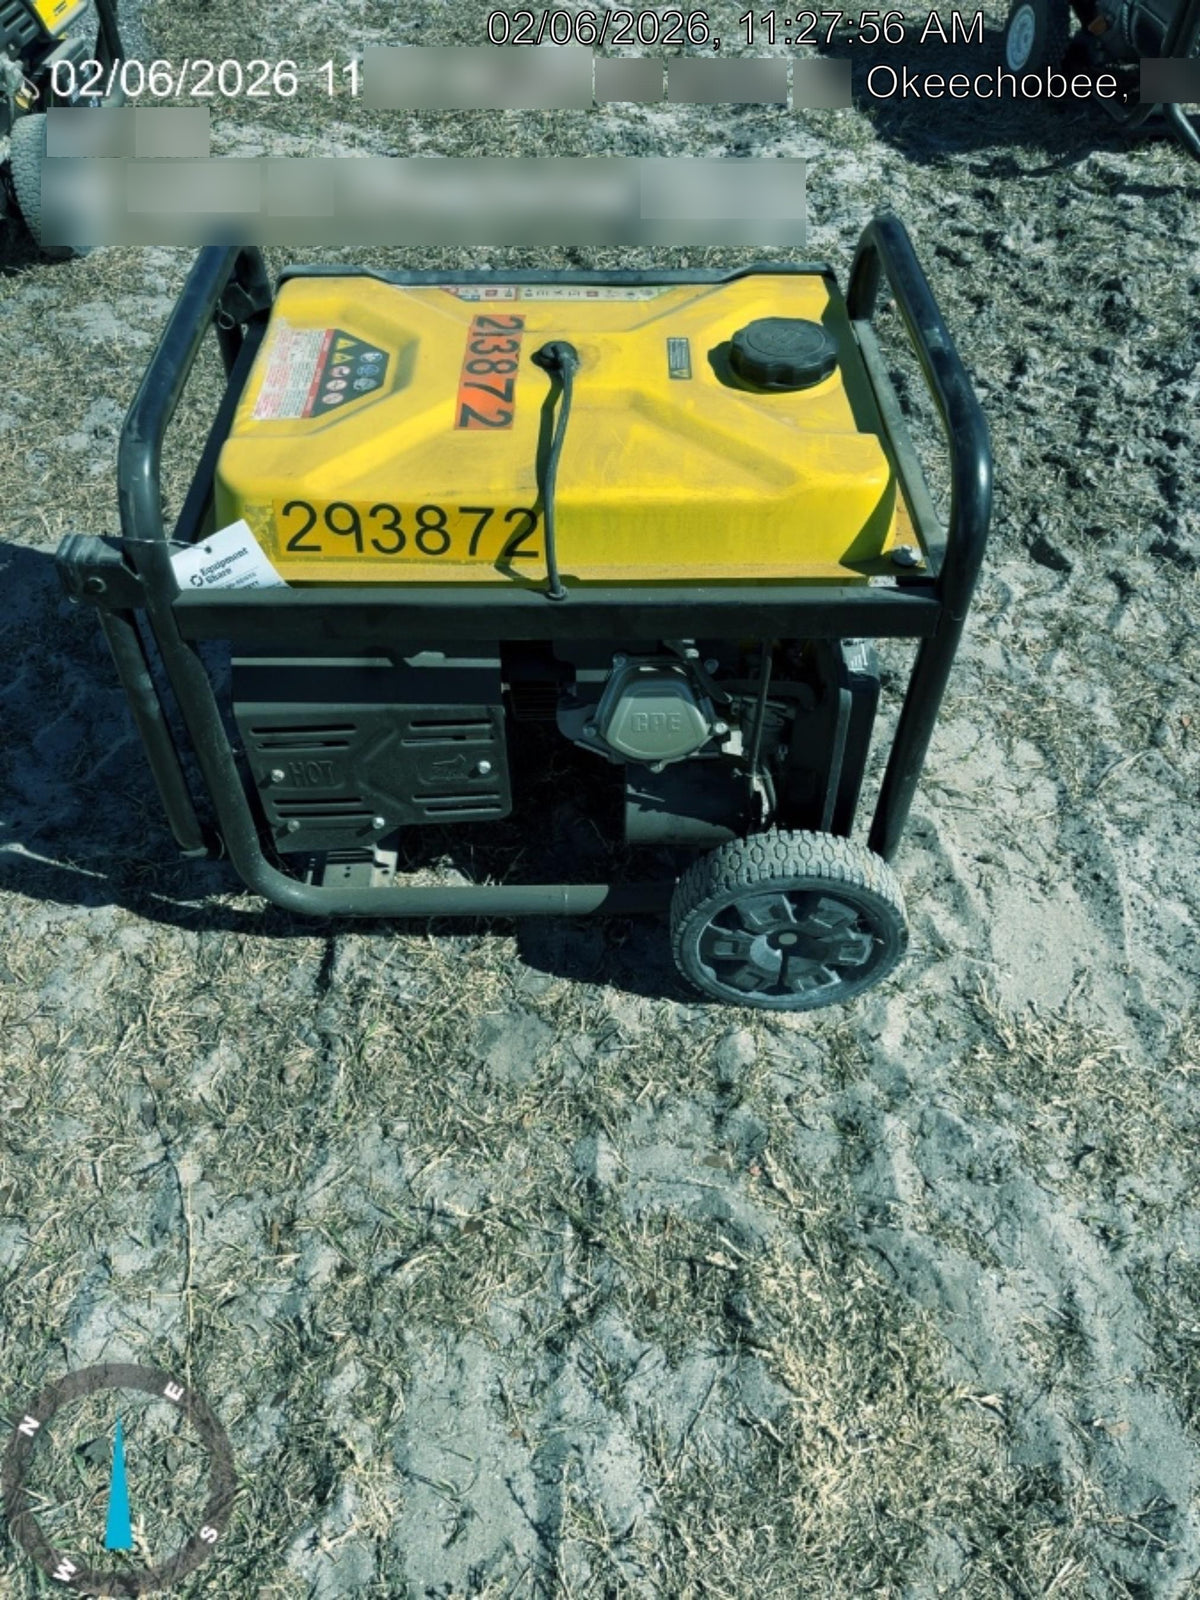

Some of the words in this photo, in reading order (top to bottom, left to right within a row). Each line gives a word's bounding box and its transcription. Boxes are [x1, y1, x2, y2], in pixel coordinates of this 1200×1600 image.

[282, 500, 539, 558] 293872
[200, 546, 248, 575] Equipment
[289, 760, 334, 786] HOT
